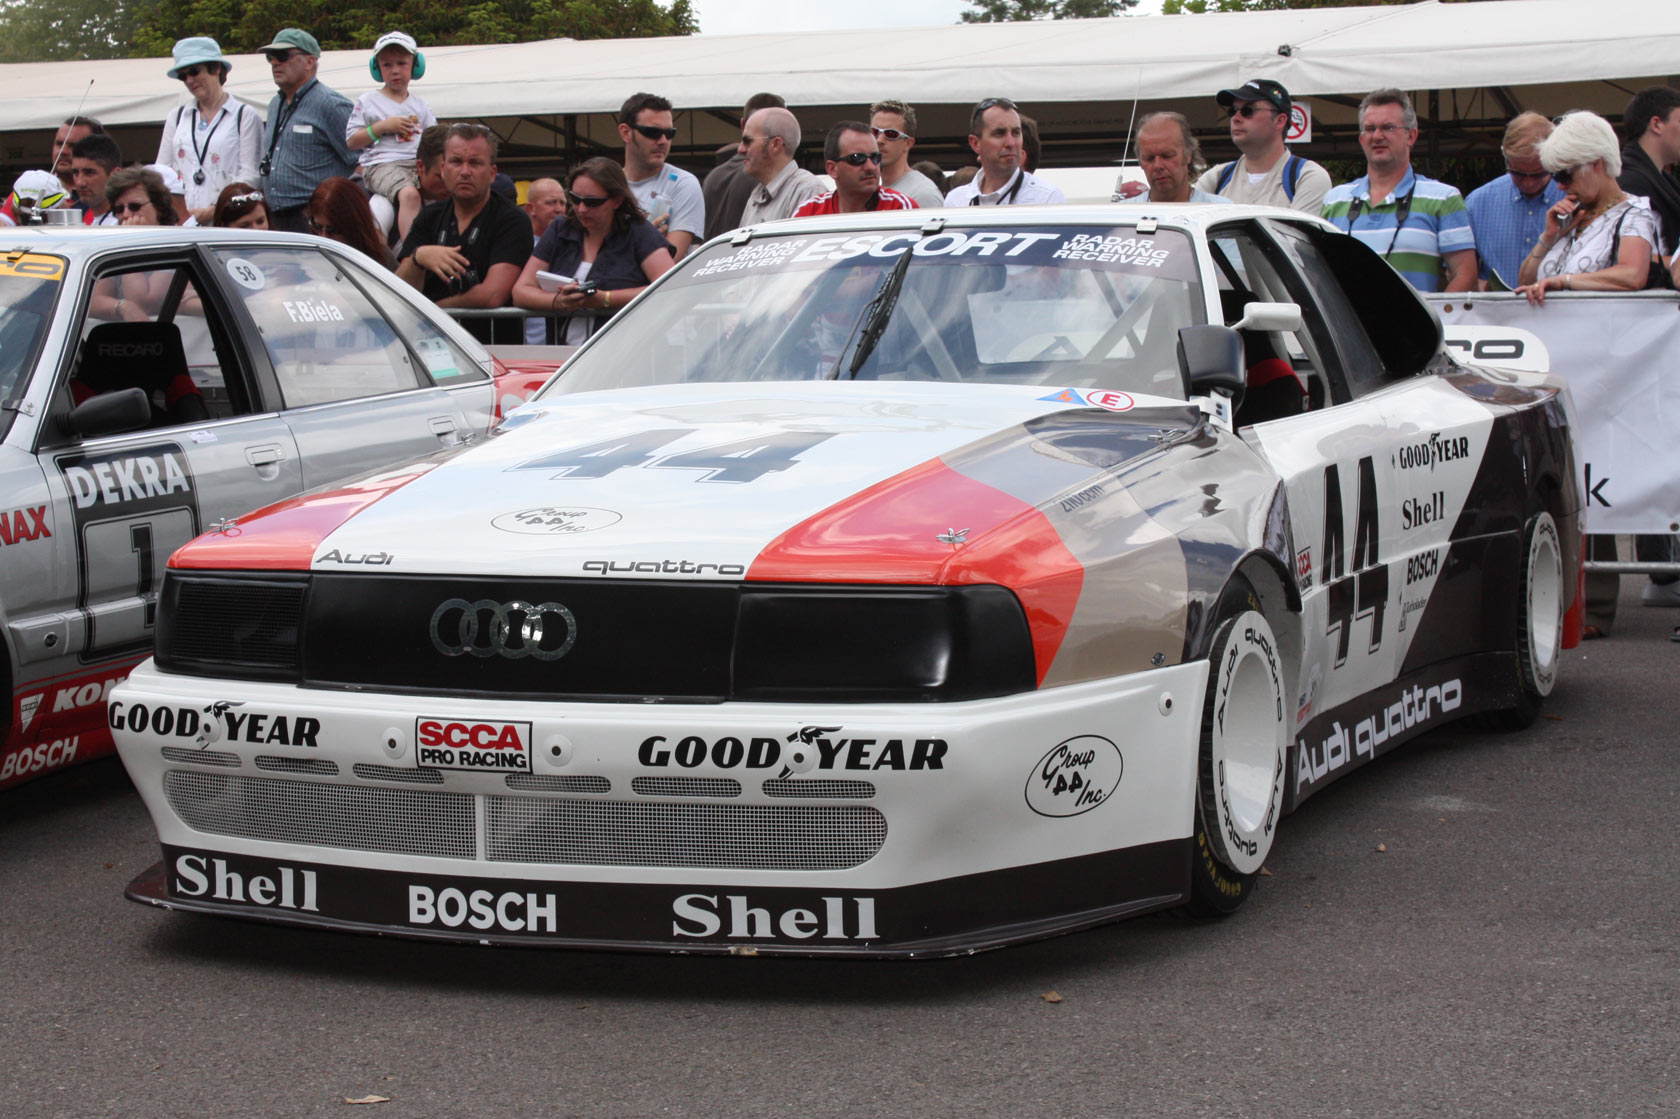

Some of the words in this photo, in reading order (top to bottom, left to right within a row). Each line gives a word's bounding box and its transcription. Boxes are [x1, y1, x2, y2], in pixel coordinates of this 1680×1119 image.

[737, 239, 808, 256] RADAR
[790, 232, 1061, 263] ESCORT
[1061, 241, 1170, 259] WARNING
[1071, 234, 1155, 249] RADAR
[692, 256, 786, 278] RECEIVER
[706, 248, 797, 267] WARNING
[1052, 250, 1165, 268] RECEIVER
[235, 266, 256, 282] 58
[282, 298, 345, 323] F.Biela
[98, 342, 163, 357] RECARO
[1100, 393, 1121, 406] E
[502, 428, 840, 484] 44
[64, 453, 190, 509] DEKRA
[515, 507, 588, 521] Group
[1402, 491, 1445, 531] Shell
[315, 549, 394, 565] Audi
[582, 560, 745, 575] quattro
[1322, 455, 1389, 670] 44
[1407, 549, 1438, 586] BOSCH
[130, 522, 157, 629] 1
[1217, 644, 1239, 736] Audi
[1245, 628, 1283, 722] quattro
[418, 720, 524, 751] SCCA
[1296, 722, 1350, 794] Audi
[1355, 678, 1462, 760] quattro
[0, 736, 79, 780] BOSCH
[420, 750, 456, 767] PRO
[458, 752, 527, 769] RACING
[1042, 745, 1095, 789] Group
[1075, 779, 1107, 807] Inc.
[1263, 748, 1283, 837] Audi
[1219, 760, 1257, 857] quattro
[175, 853, 320, 911] Shell
[408, 884, 557, 932] BOSCH
[672, 893, 880, 940] Shell
